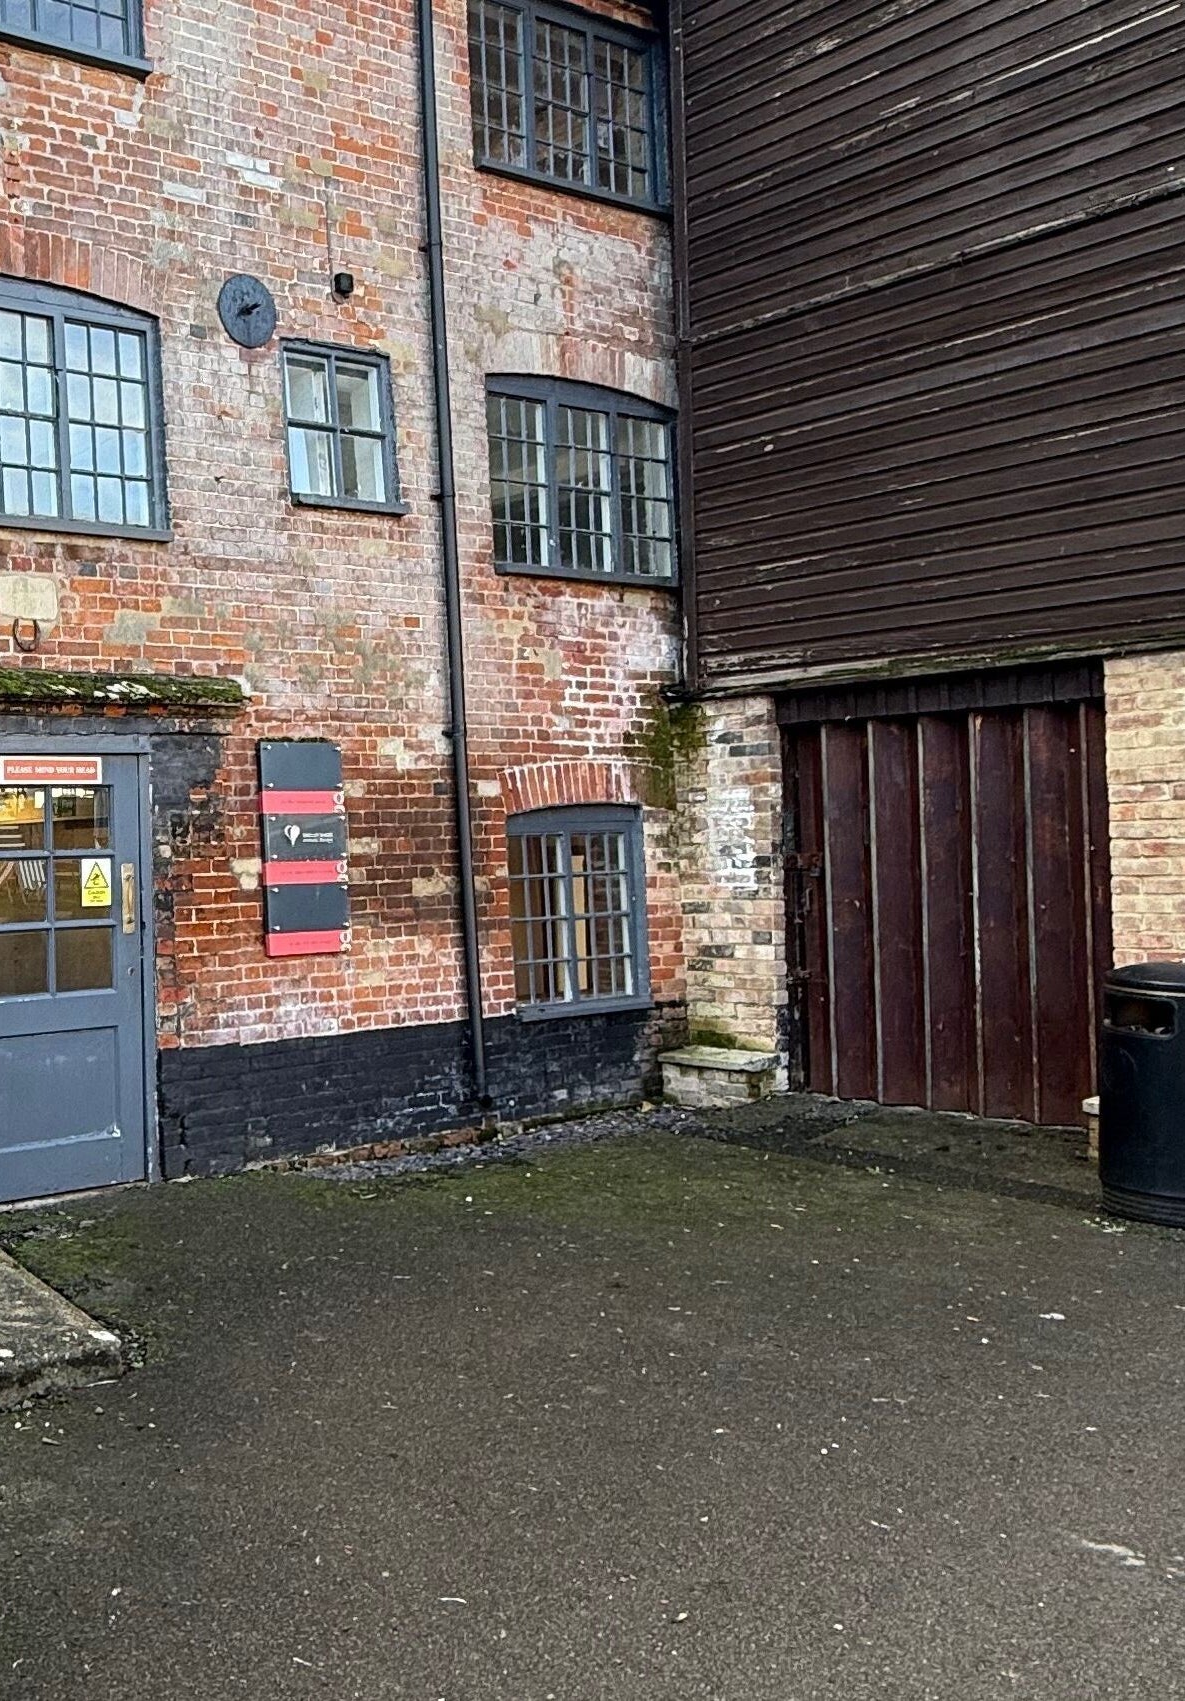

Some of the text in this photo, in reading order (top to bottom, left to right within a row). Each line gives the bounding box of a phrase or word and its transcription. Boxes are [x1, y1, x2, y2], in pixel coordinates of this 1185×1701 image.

[6, 766, 96, 774] PLEASE MIND YOUR HEAD
